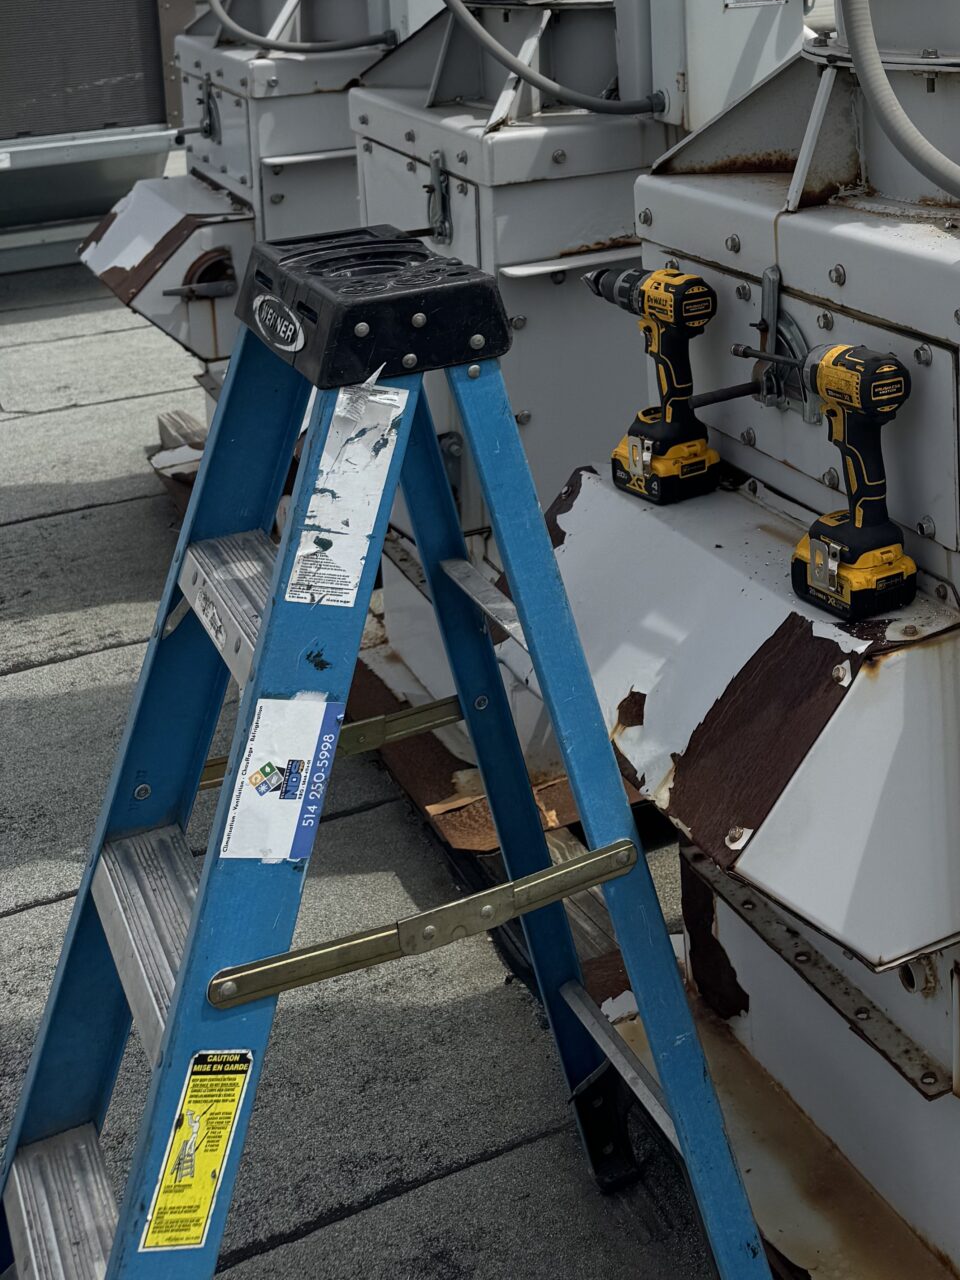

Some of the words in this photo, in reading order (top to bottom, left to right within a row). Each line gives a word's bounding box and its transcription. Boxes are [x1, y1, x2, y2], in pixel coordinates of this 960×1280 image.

[285, 760, 302, 799] NDS
[309, 733, 335, 800] 250-5998
[222, 815, 236, 853] Climatisation
[233, 780, 245, 812] Ventilation
[241, 747, 254, 776] Chauffage
[302, 804, 318, 827] 514
[193, 1064, 212, 1072] MISE
[224, 1063, 249, 1071] GARDE
[207, 1054, 240, 1063] CAUTION
